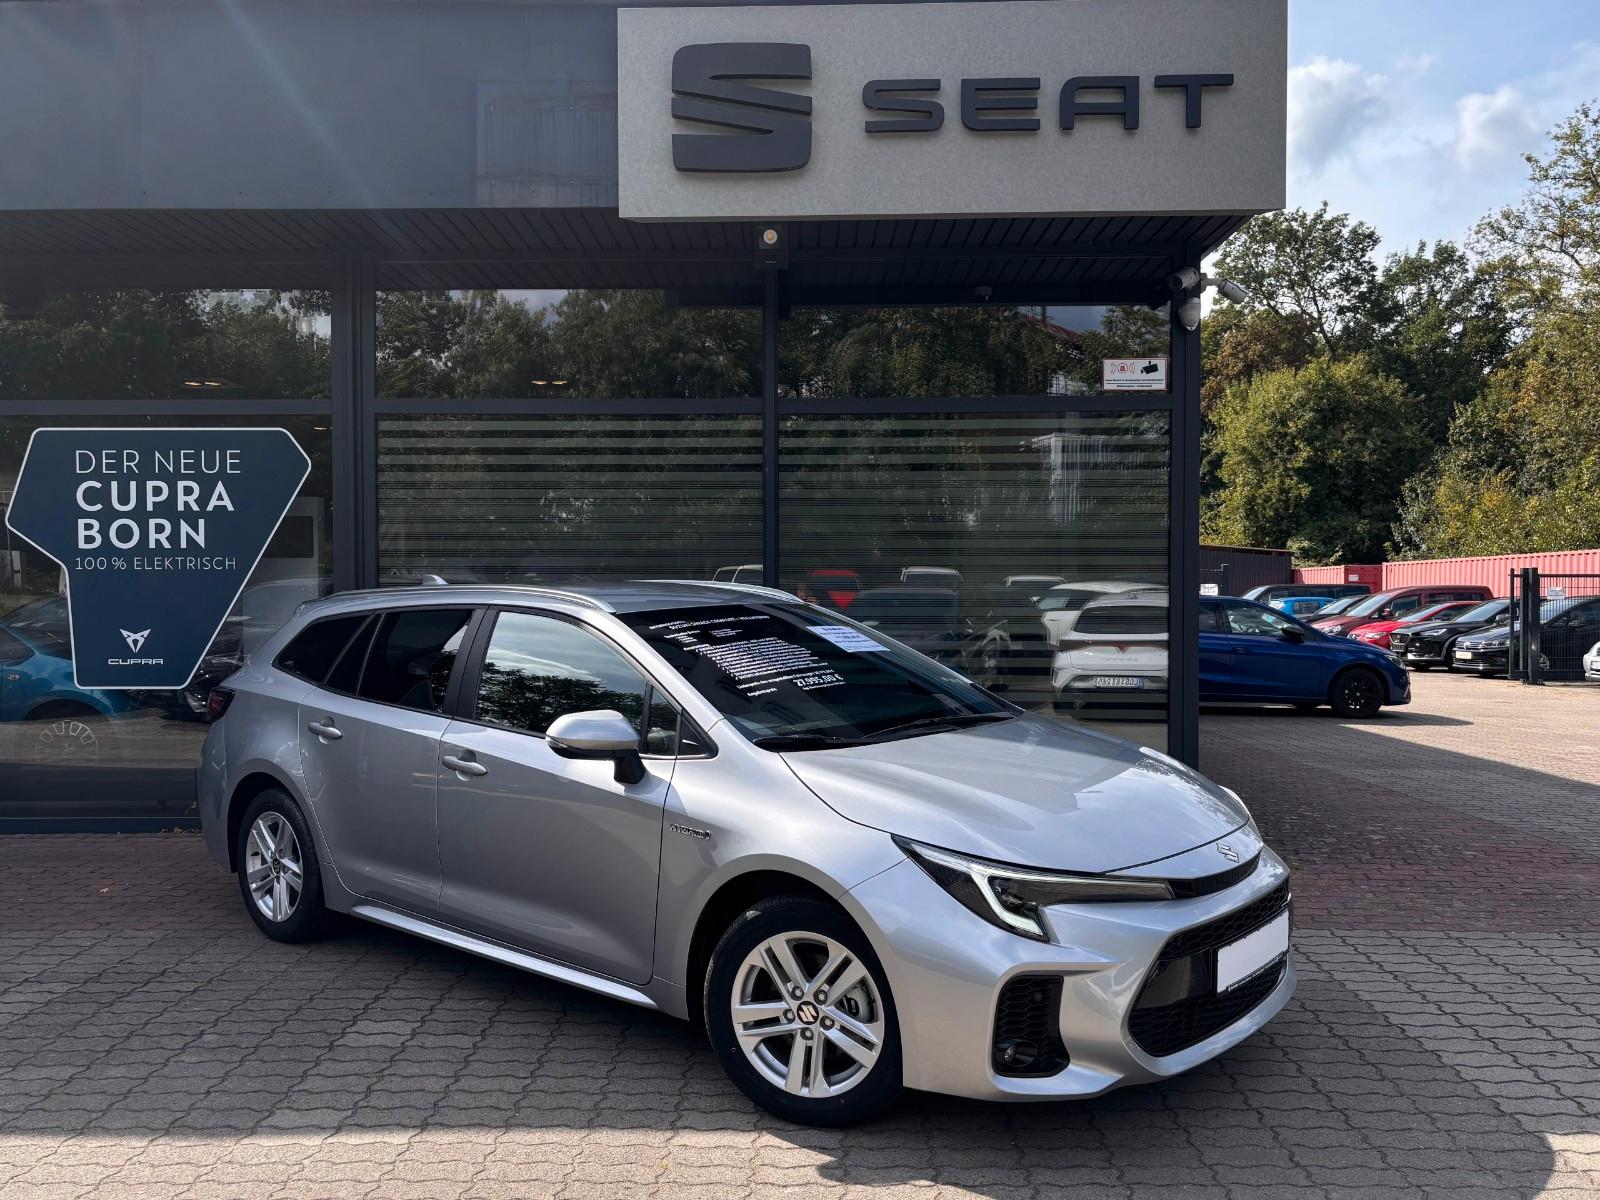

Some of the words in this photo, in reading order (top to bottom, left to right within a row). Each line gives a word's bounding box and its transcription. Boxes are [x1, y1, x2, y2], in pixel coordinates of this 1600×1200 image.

[862, 73, 1234, 133] SEAT
[75, 450, 140, 474] DER
[155, 450, 241, 474] NEUE
[76, 481, 235, 512] CUPRA
[77, 518, 205, 550] BORN
[75, 557, 107, 570] 100
[111, 557, 127, 570] %
[134, 557, 236, 570] ELEKTRISCH
